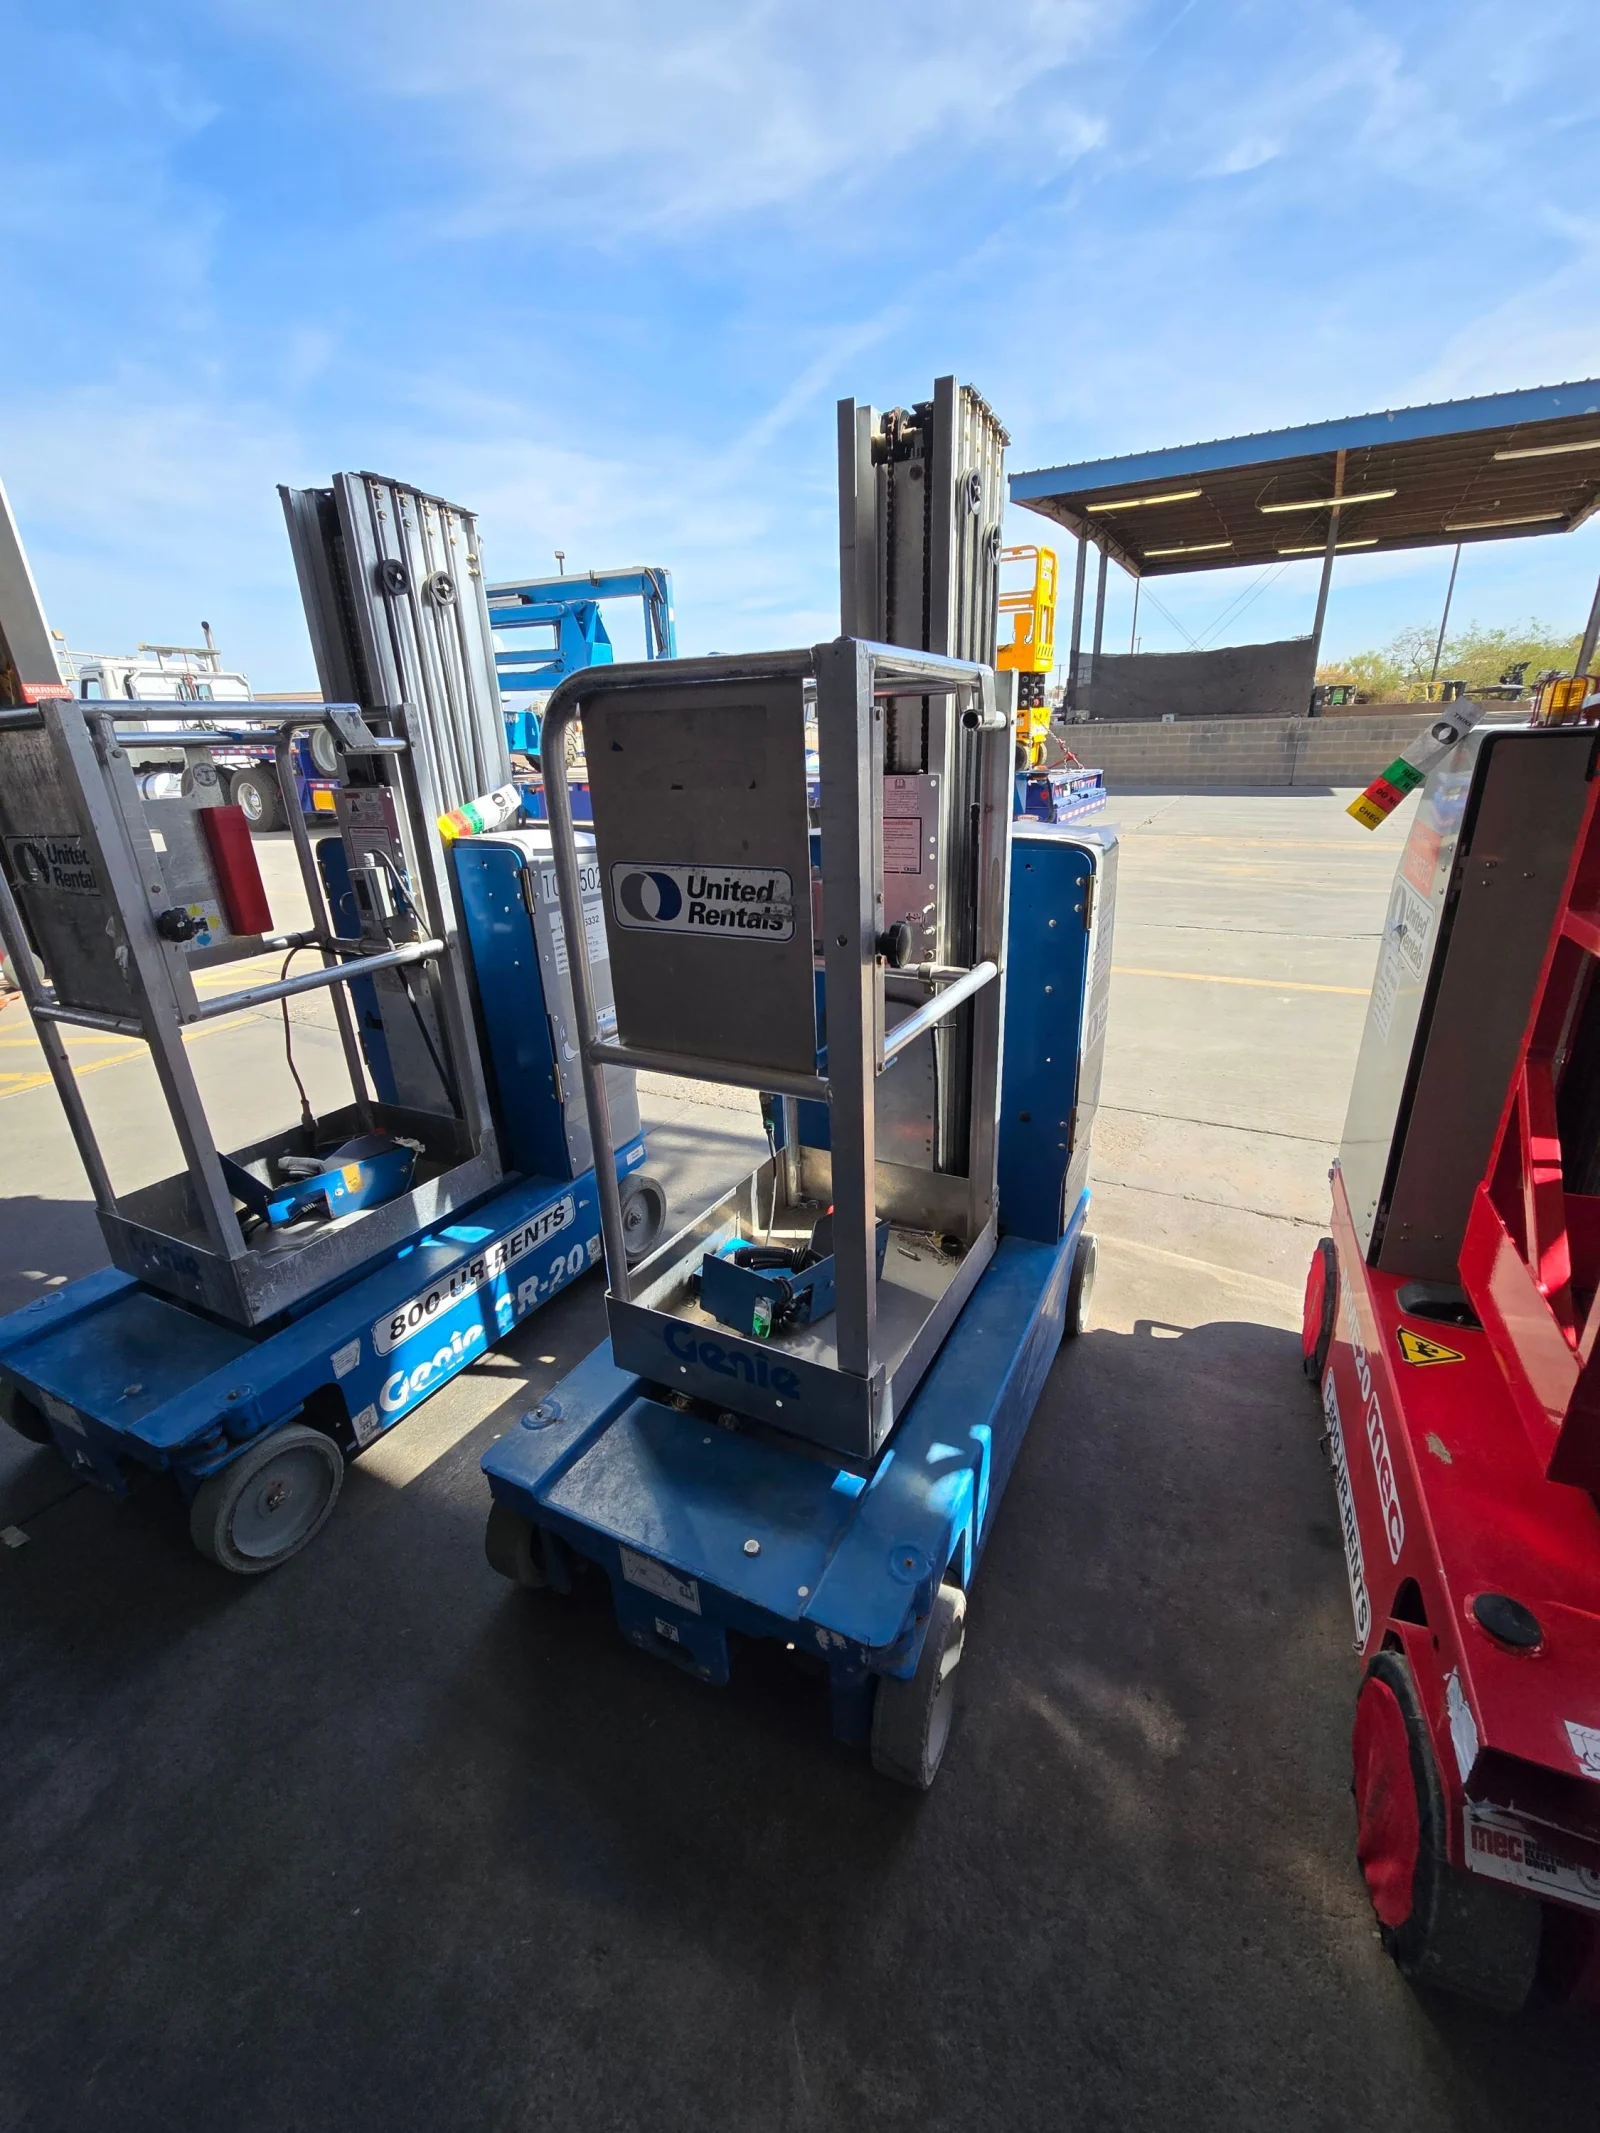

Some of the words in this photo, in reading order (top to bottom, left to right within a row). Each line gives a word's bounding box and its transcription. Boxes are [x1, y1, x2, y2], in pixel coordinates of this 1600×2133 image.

[24, 686, 70, 694] WARNING
[1453, 712, 1473, 728] THINK
[1375, 787, 1389, 798] DO
[687, 875, 775, 903] United
[688, 901, 784, 931] Rentals
[1406, 897, 1431, 940] United
[379, 1324, 484, 1412] Genie
[663, 1321, 801, 1400] Genie
[1367, 1395, 1405, 1560] mec
[1327, 1382, 1368, 1633] 1-800-UR-RENTS
[1471, 1824, 1523, 1864] mec
[1525, 1857, 1558, 1875] DRIVE
